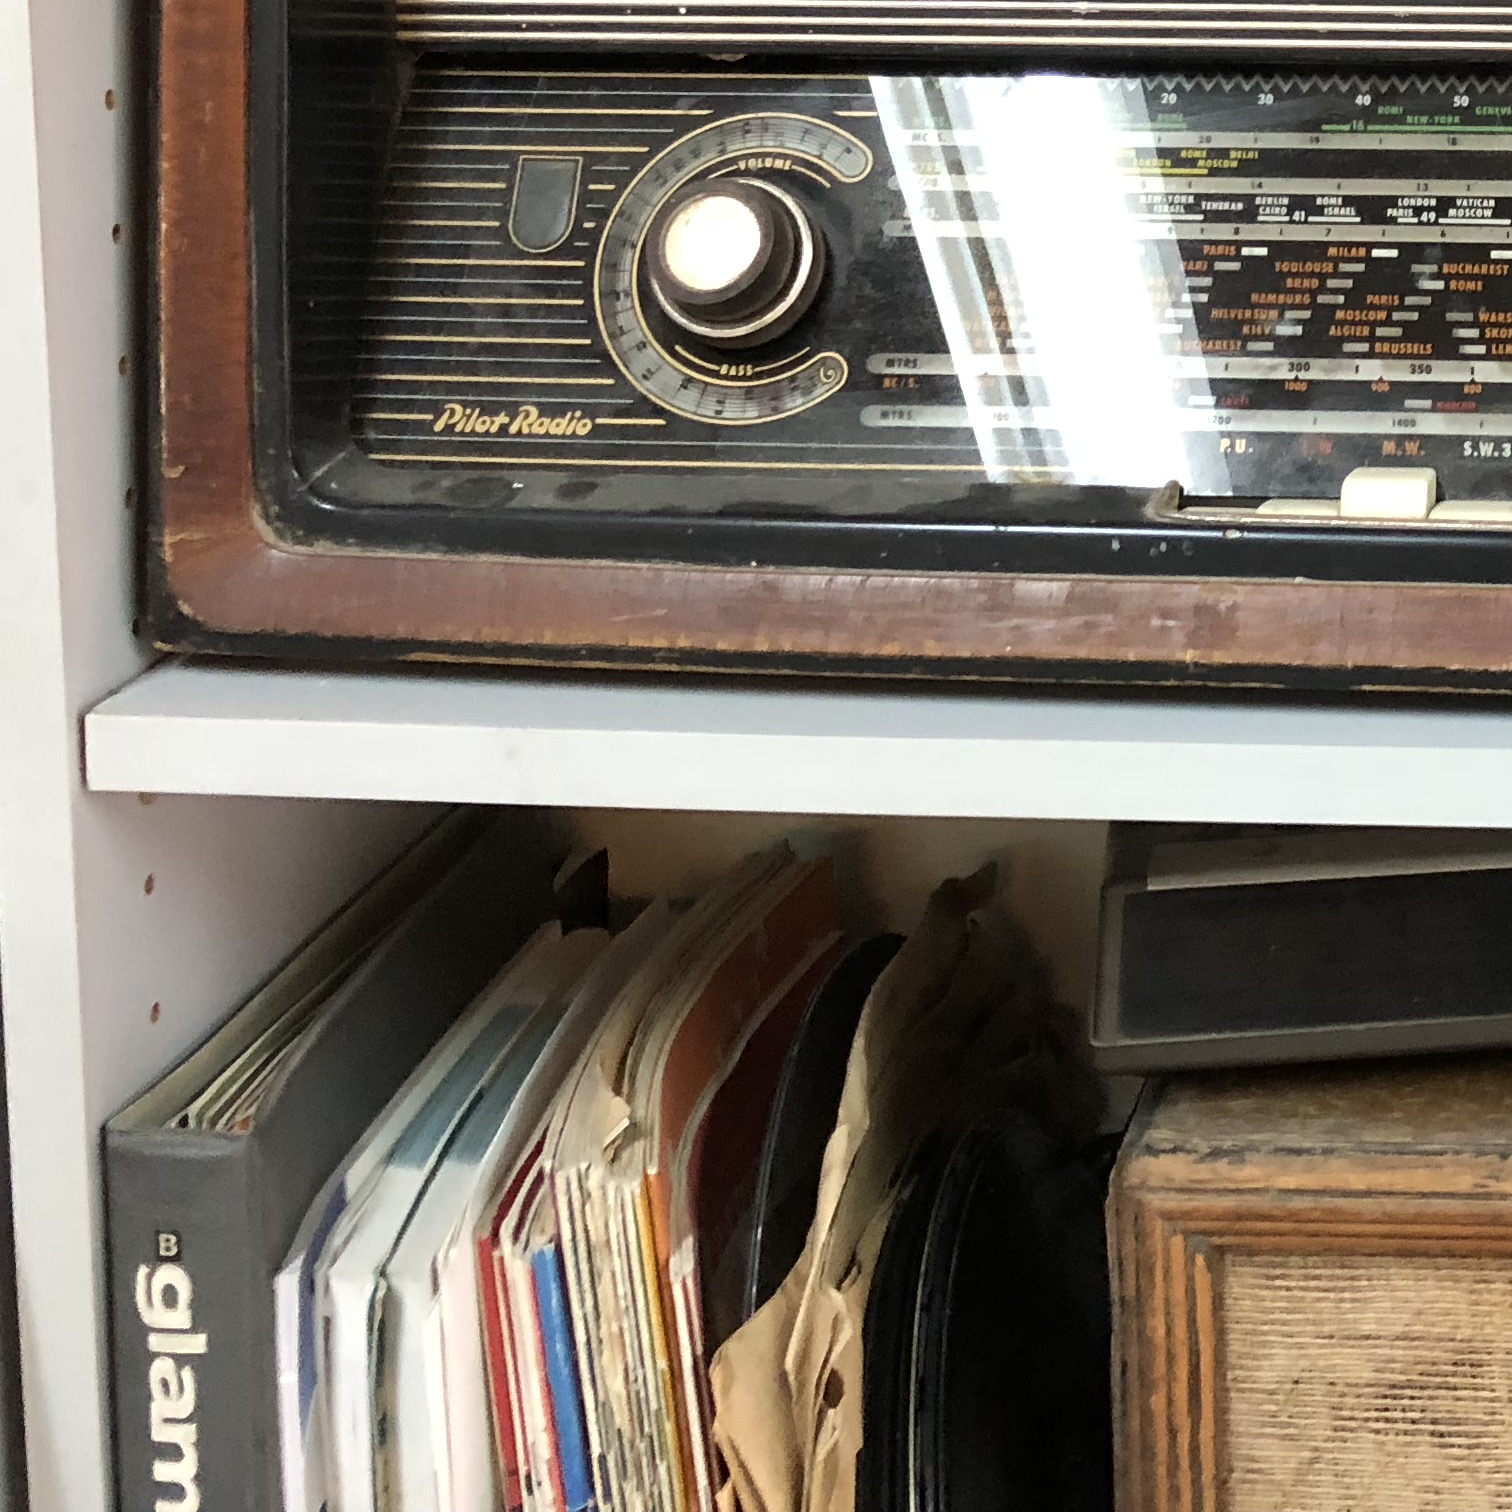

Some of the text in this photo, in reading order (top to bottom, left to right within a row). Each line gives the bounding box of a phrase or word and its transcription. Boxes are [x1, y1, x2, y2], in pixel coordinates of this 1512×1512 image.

[1161, 93, 1177, 104] 20
[1258, 94, 1274, 105] 30
[1355, 95, 1371, 106] 40
[1453, 96, 1469, 107] 50
[1378, 106, 1403, 114] ROME
[1406, 115, 1461, 124] NEW-YORK
[1230, 151, 1258, 159] DELHI
[738, 157, 792, 171] VOLUME
[1197, 160, 1239, 168] MOSCOW
[1417, 183, 1428, 191] 13
[1255, 197, 1289, 205] BERLIN
[1316, 197, 1343, 205] ROME
[1398, 198, 1436, 206] LONDON
[1456, 199, 1495, 207] VATICAN
[1259, 207, 1287, 215] CAIRO
[1324, 207, 1356, 215] ISRAEL
[1387, 209, 1413, 217] PARIS
[1448, 209, 1493, 217] MOSCOW
[1292, 211, 1305, 222] 41
[1420, 212, 1436, 223] 49
[1203, 245, 1236, 256] PARIS
[1327, 247, 1366, 257] MILAN
[1274, 262, 1334, 272] TOULOUSE
[1442, 264, 1509, 275] BUCHAREST
[1286, 278, 1319, 288] BRNO
[1450, 280, 1483, 291] ROME
[1251, 294, 1311, 303] HAMBURG
[1366, 295, 1399, 305] PARIS
[1211, 308, 1279, 319] HILVERSUM
[1335, 310, 1388, 321] MOSCOW
[1242, 325, 1272, 335] KIEV
[1329, 325, 1370, 336] ALGIER
[1374, 343, 1432, 354] BRUSSELS
[720, 364, 754, 375] BASS
[1288, 362, 1310, 372] 300
[1410, 364, 1432, 374] 350
[433, 403, 592, 435] Pilot Radio
[1219, 438, 1253, 453] P.U.
[1382, 441, 1425, 456] M.W.
[1464, 441, 1512, 457] S.W.3
